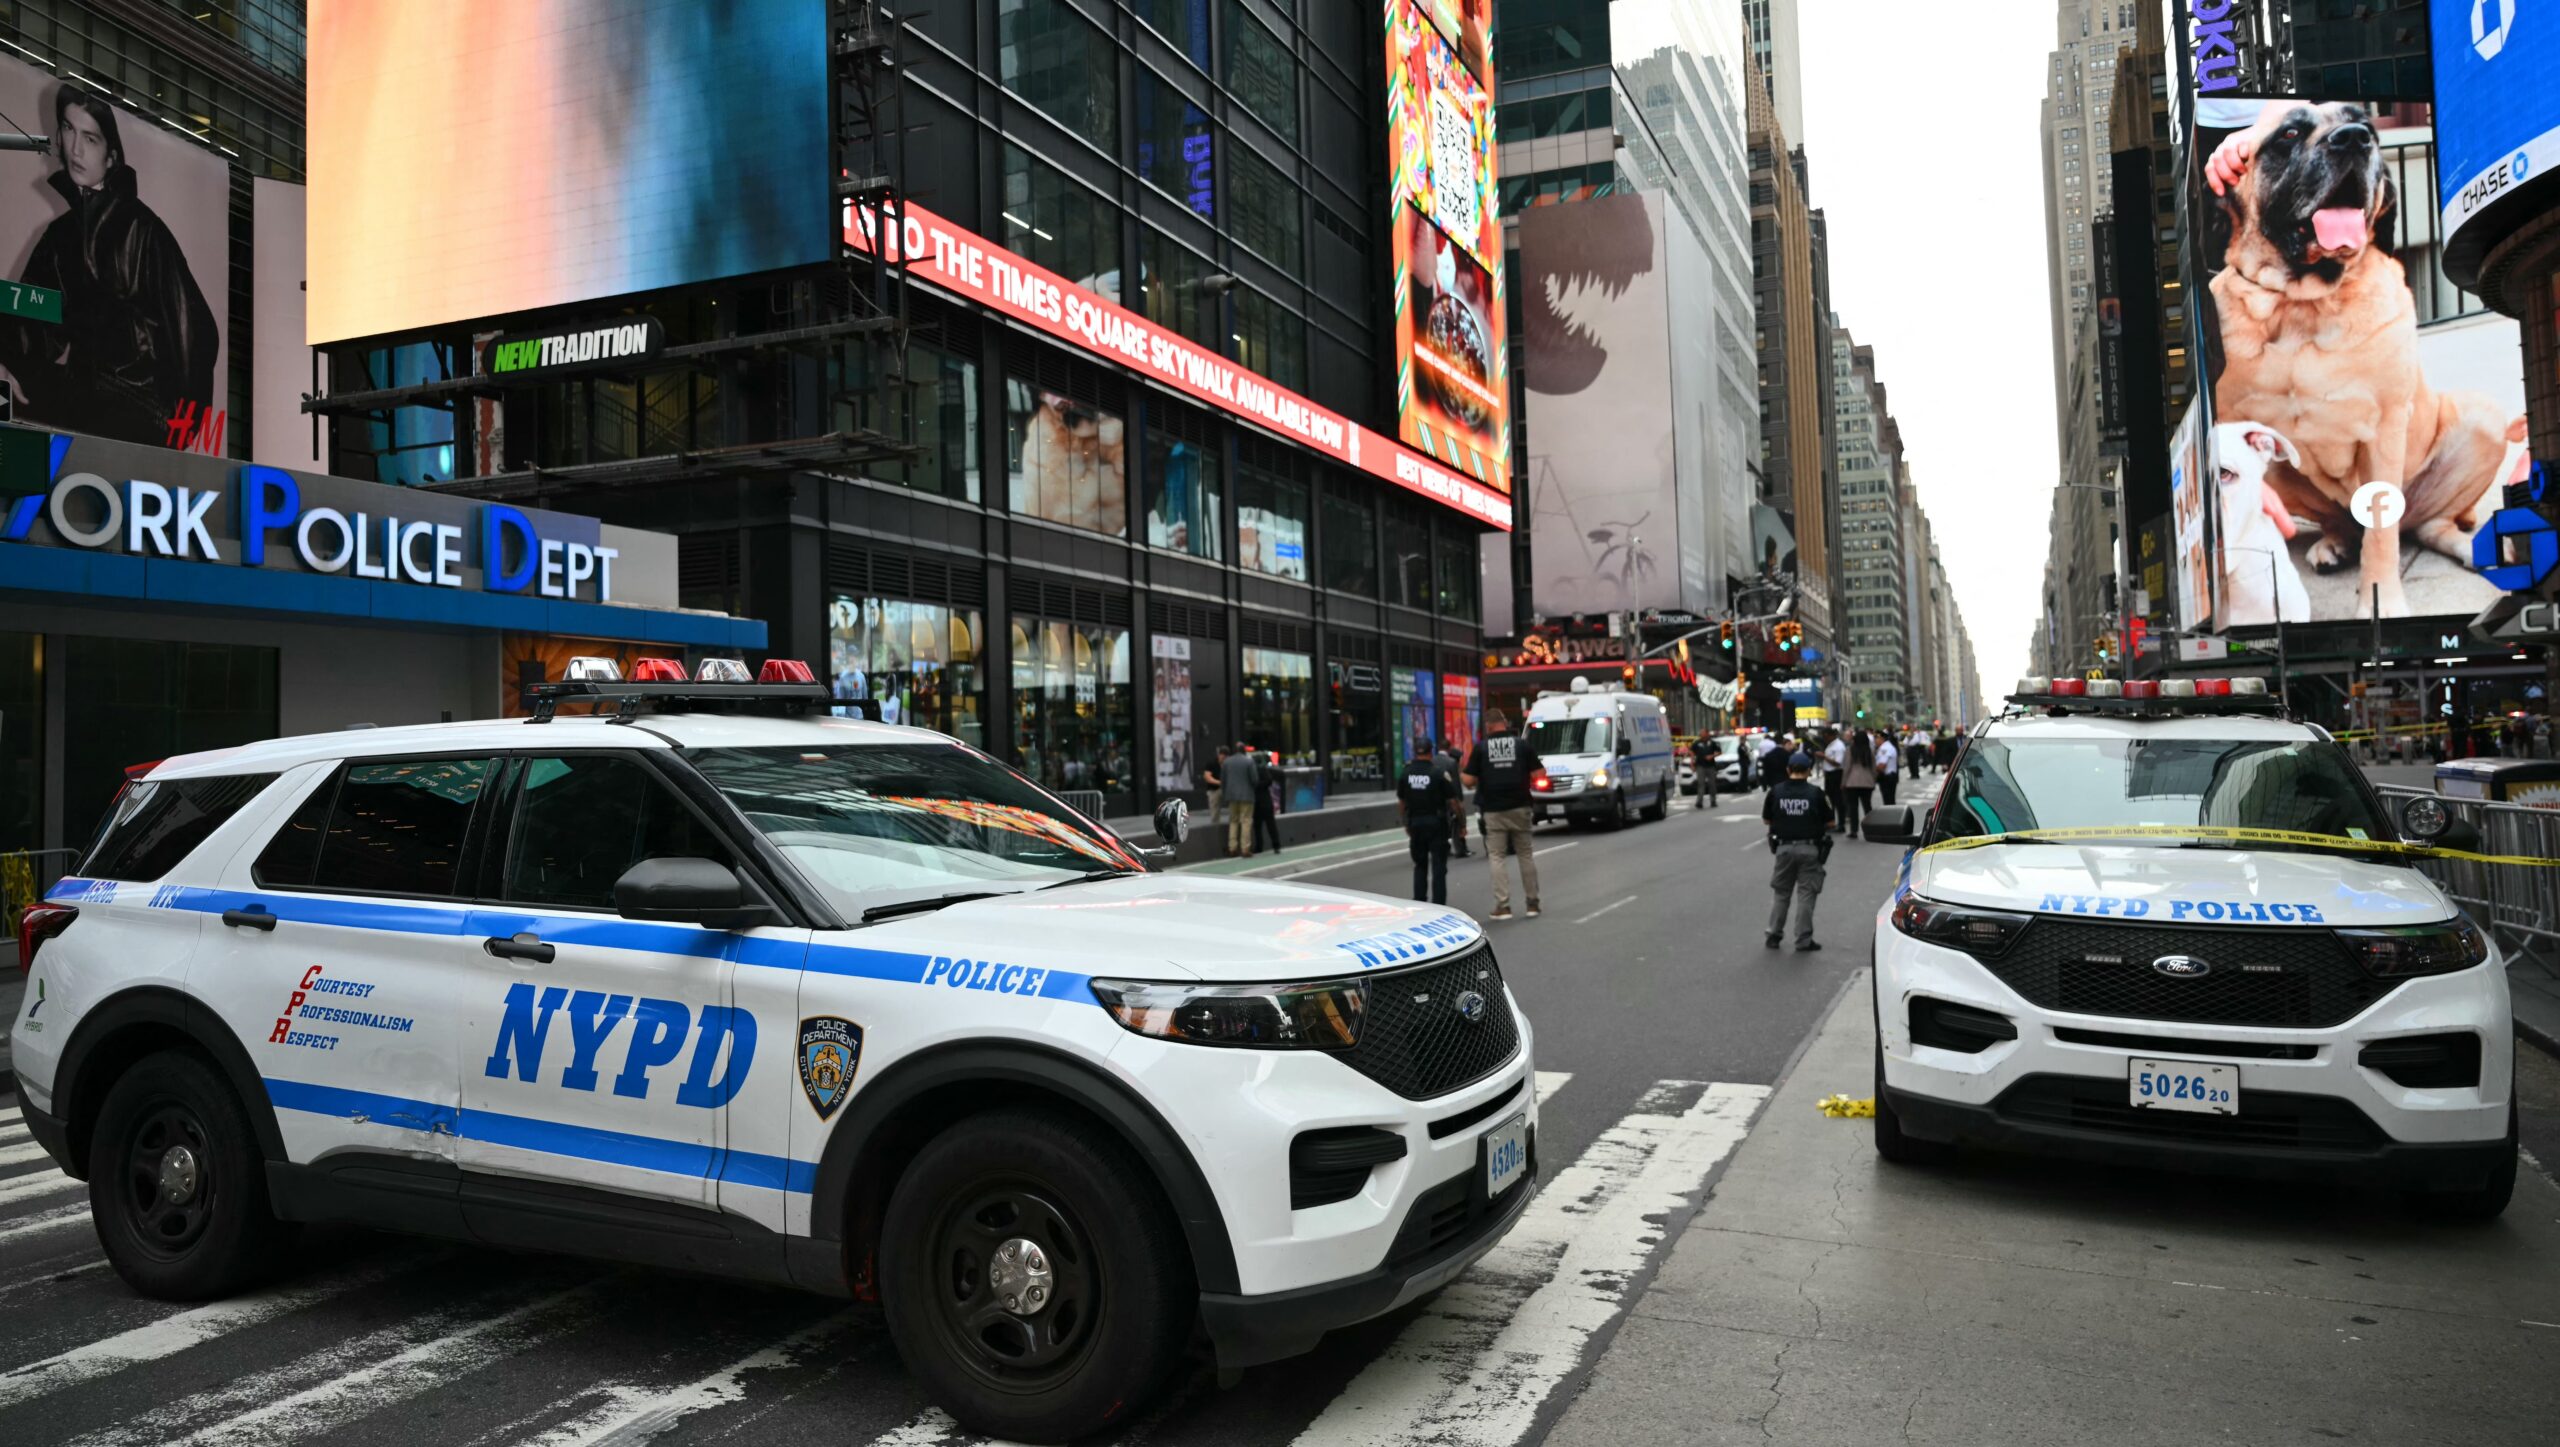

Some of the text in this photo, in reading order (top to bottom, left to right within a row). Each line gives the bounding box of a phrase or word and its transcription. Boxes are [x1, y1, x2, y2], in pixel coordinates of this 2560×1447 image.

[2462, 164, 2509, 214] CHASE
[10, 286, 44, 310] 7 Av
[493, 322, 648, 373] NEWTRADITION
[930, 226, 984, 289] THE
[988, 255, 1062, 323] TIMES
[1065, 294, 1149, 363] SQUARE
[1150, 335, 1235, 403] SKYWALK
[1236, 377, 1310, 437] AVAILABLE
[1310, 410, 1343, 450] NOW
[2108, 341, 2119, 422] SQUARE
[166, 397, 226, 457] H&M
[241, 463, 462, 587] POLICE
[483, 503, 620, 602] DEPT
[1488, 737, 1515, 750] NYPD
[1489, 749, 1516, 759] POLICE
[1408, 774, 1430, 785] NYPD
[1779, 798, 1810, 810] NYPD
[2039, 893, 2325, 924] NYPD POLICE
[299, 964, 376, 998] COURTESY
[924, 956, 1046, 997] POLICE
[2166, 959, 2198, 973] Ford
[24, 1020, 44, 1033] HYBRID
[283, 991, 414, 1033] PROFESSIONALISM
[816, 1019, 848, 1034] POLICE
[268, 1017, 340, 1051] RESPECT
[484, 982, 758, 1110] NYPD
[802, 1029, 858, 1051] DEPARTMENT
[800, 1056, 816, 1098] CITY OF
[832, 1058, 857, 1106] NEW YORK
[2138, 1072, 2230, 1103] 5026 20
[1491, 1138, 1516, 1182] 4520
